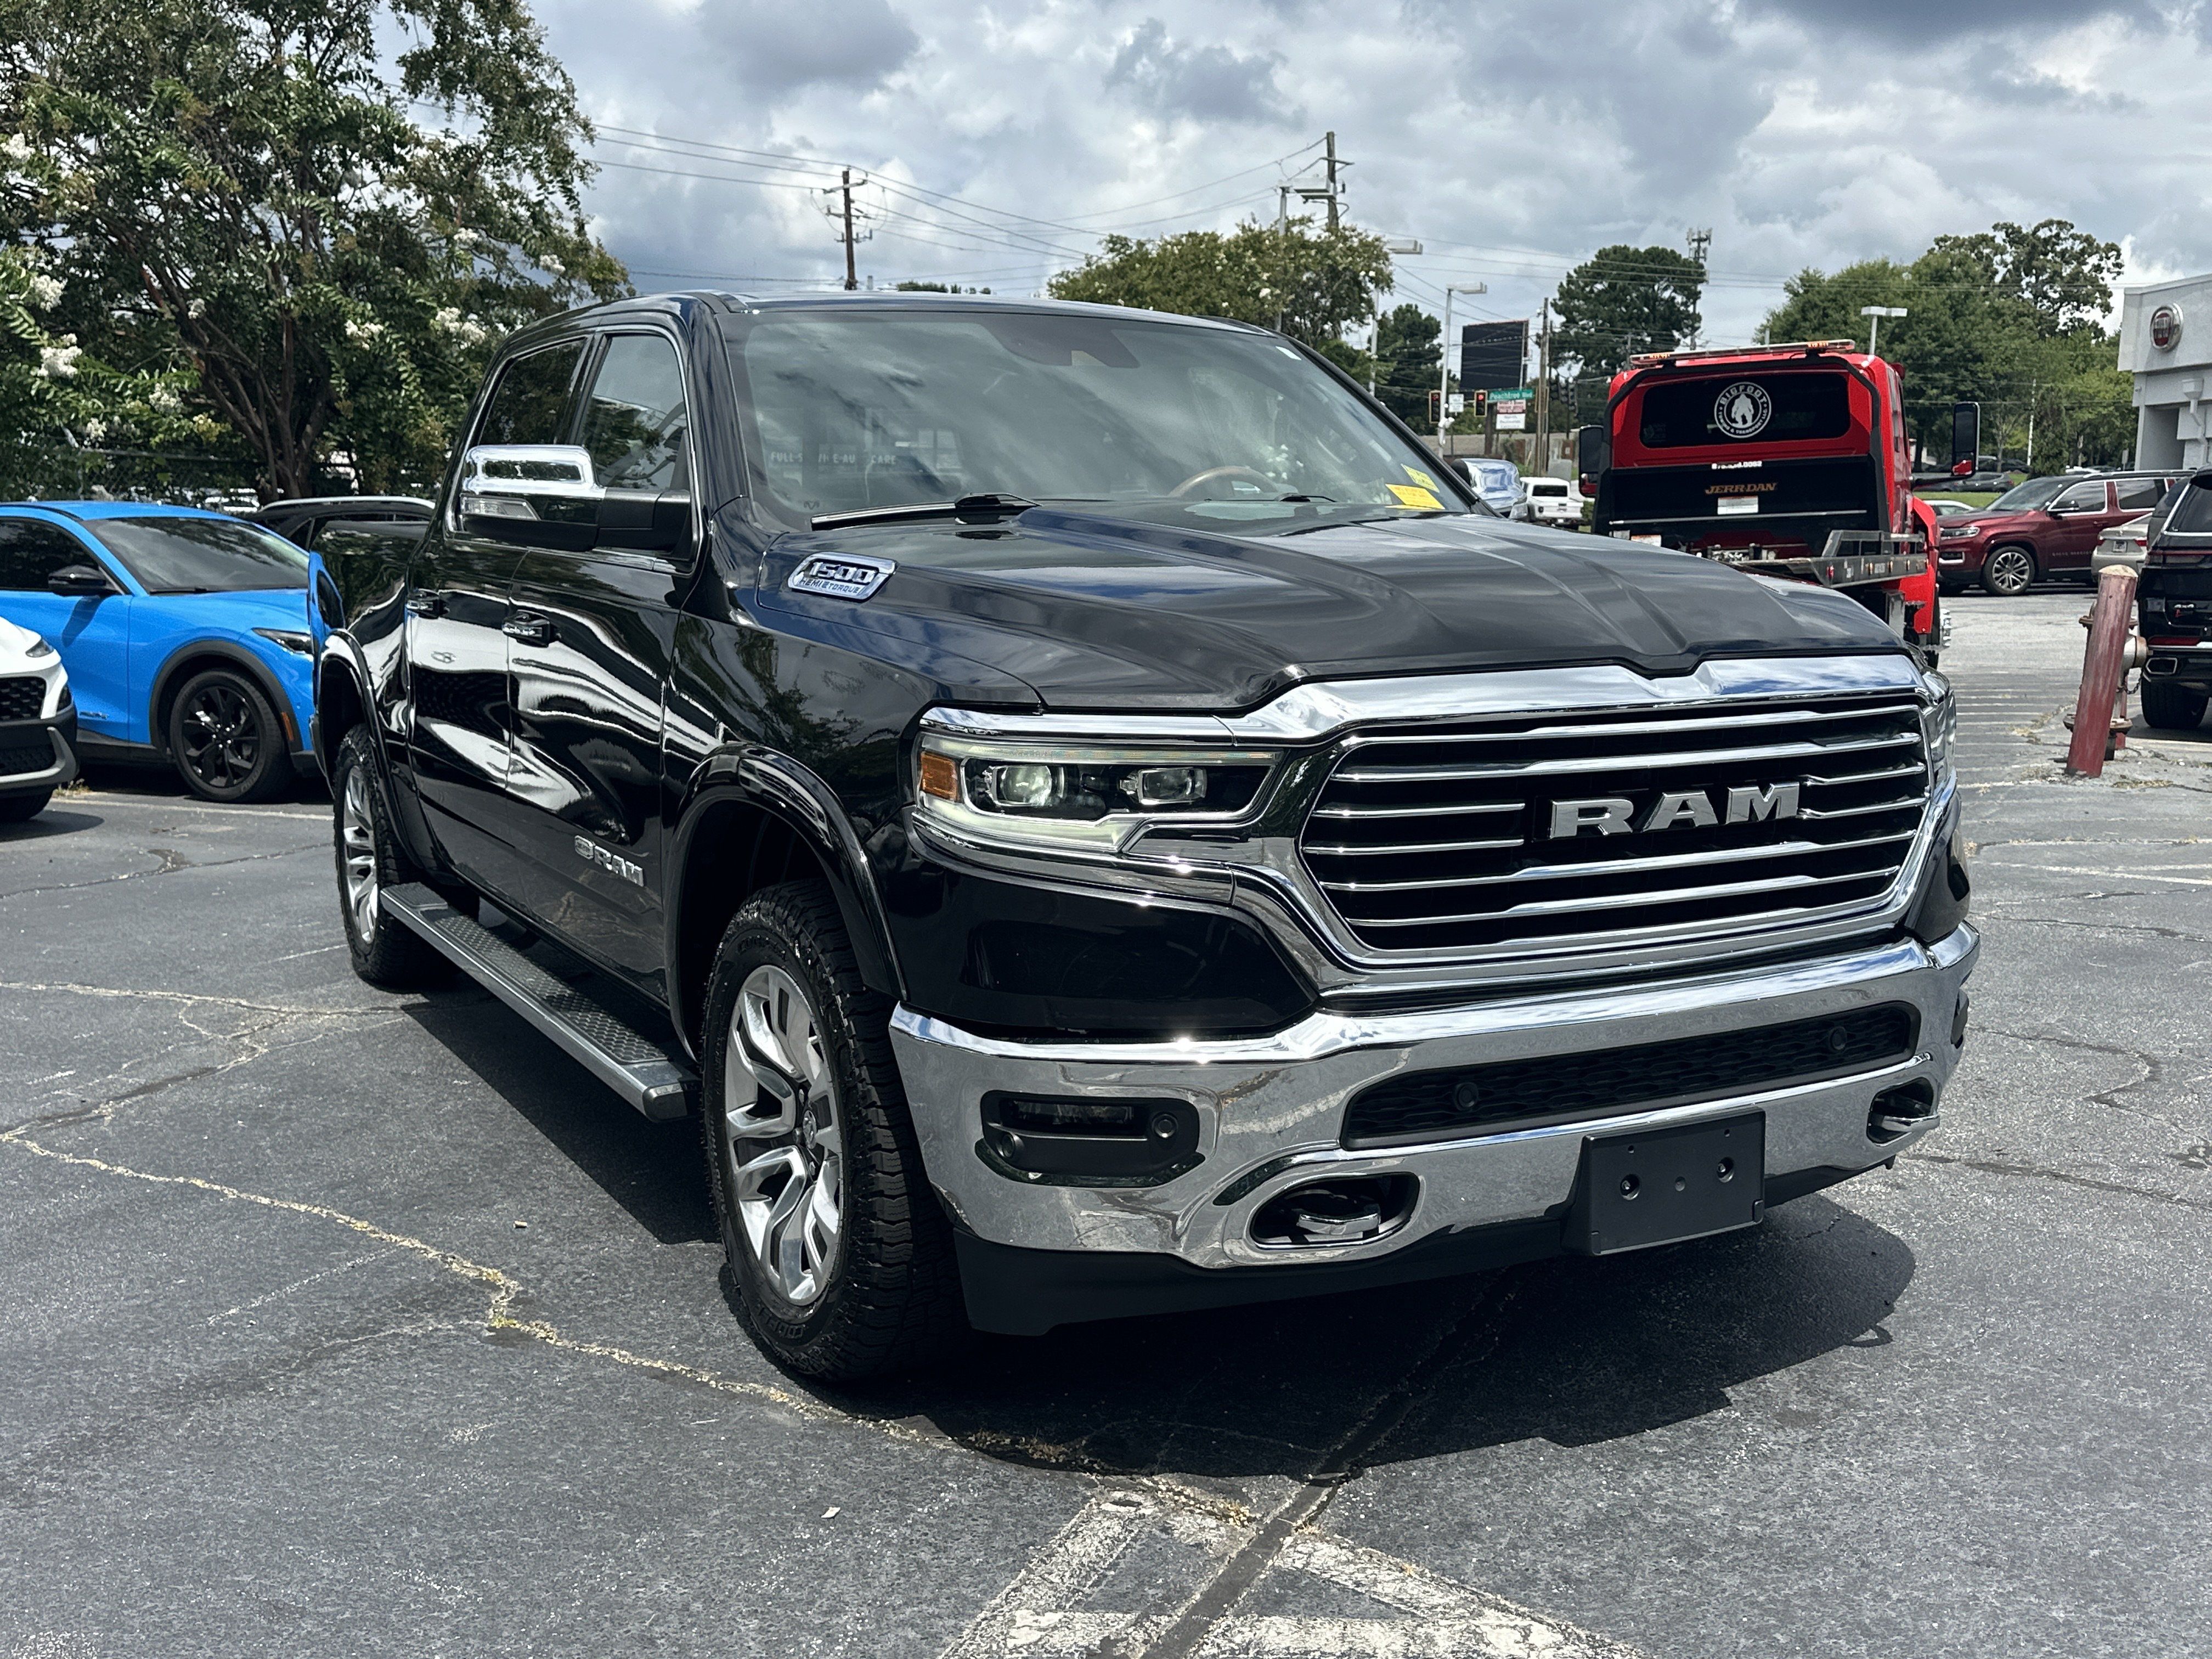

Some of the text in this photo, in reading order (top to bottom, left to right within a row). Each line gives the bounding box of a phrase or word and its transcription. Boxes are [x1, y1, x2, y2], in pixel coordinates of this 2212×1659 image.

[1719, 385, 1767, 405] BIGFOOT
[799, 579, 823, 587] HEMI
[809, 562, 876, 583] 1500
[1549, 781, 1801, 839] RAM
[594, 845, 644, 887] RAM
